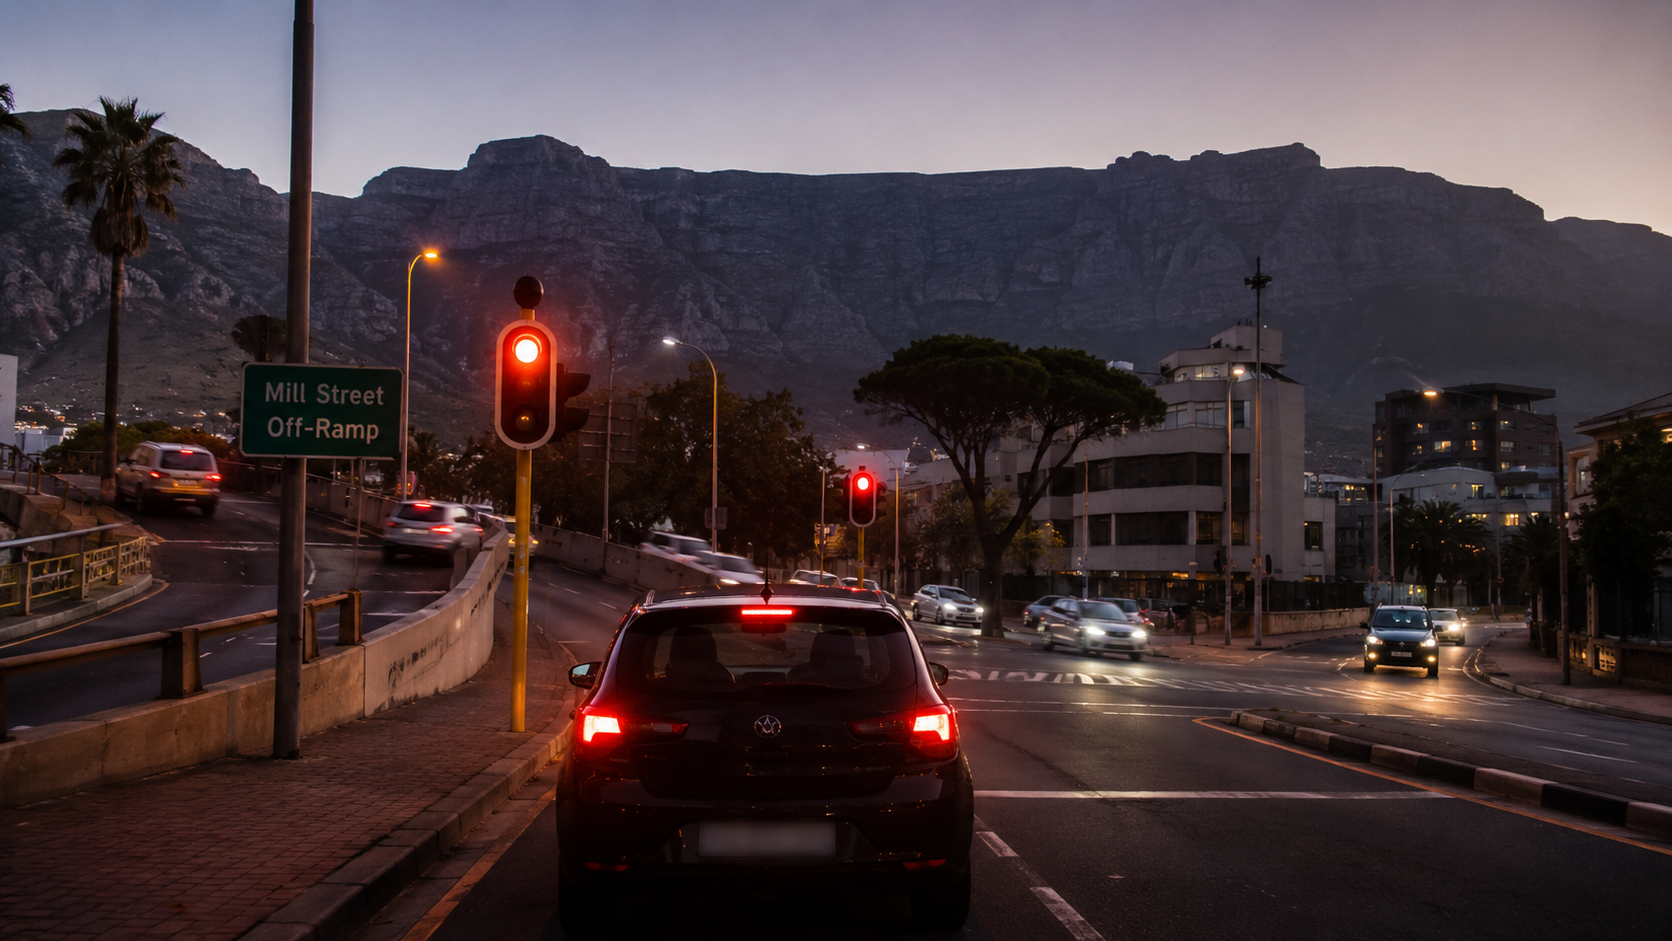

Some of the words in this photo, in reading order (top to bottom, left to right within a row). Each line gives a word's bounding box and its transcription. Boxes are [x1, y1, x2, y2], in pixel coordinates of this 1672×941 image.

[265, 381, 306, 403] Mill
[316, 383, 384, 405] Street
[267, 416, 379, 445] Off-Ramp
